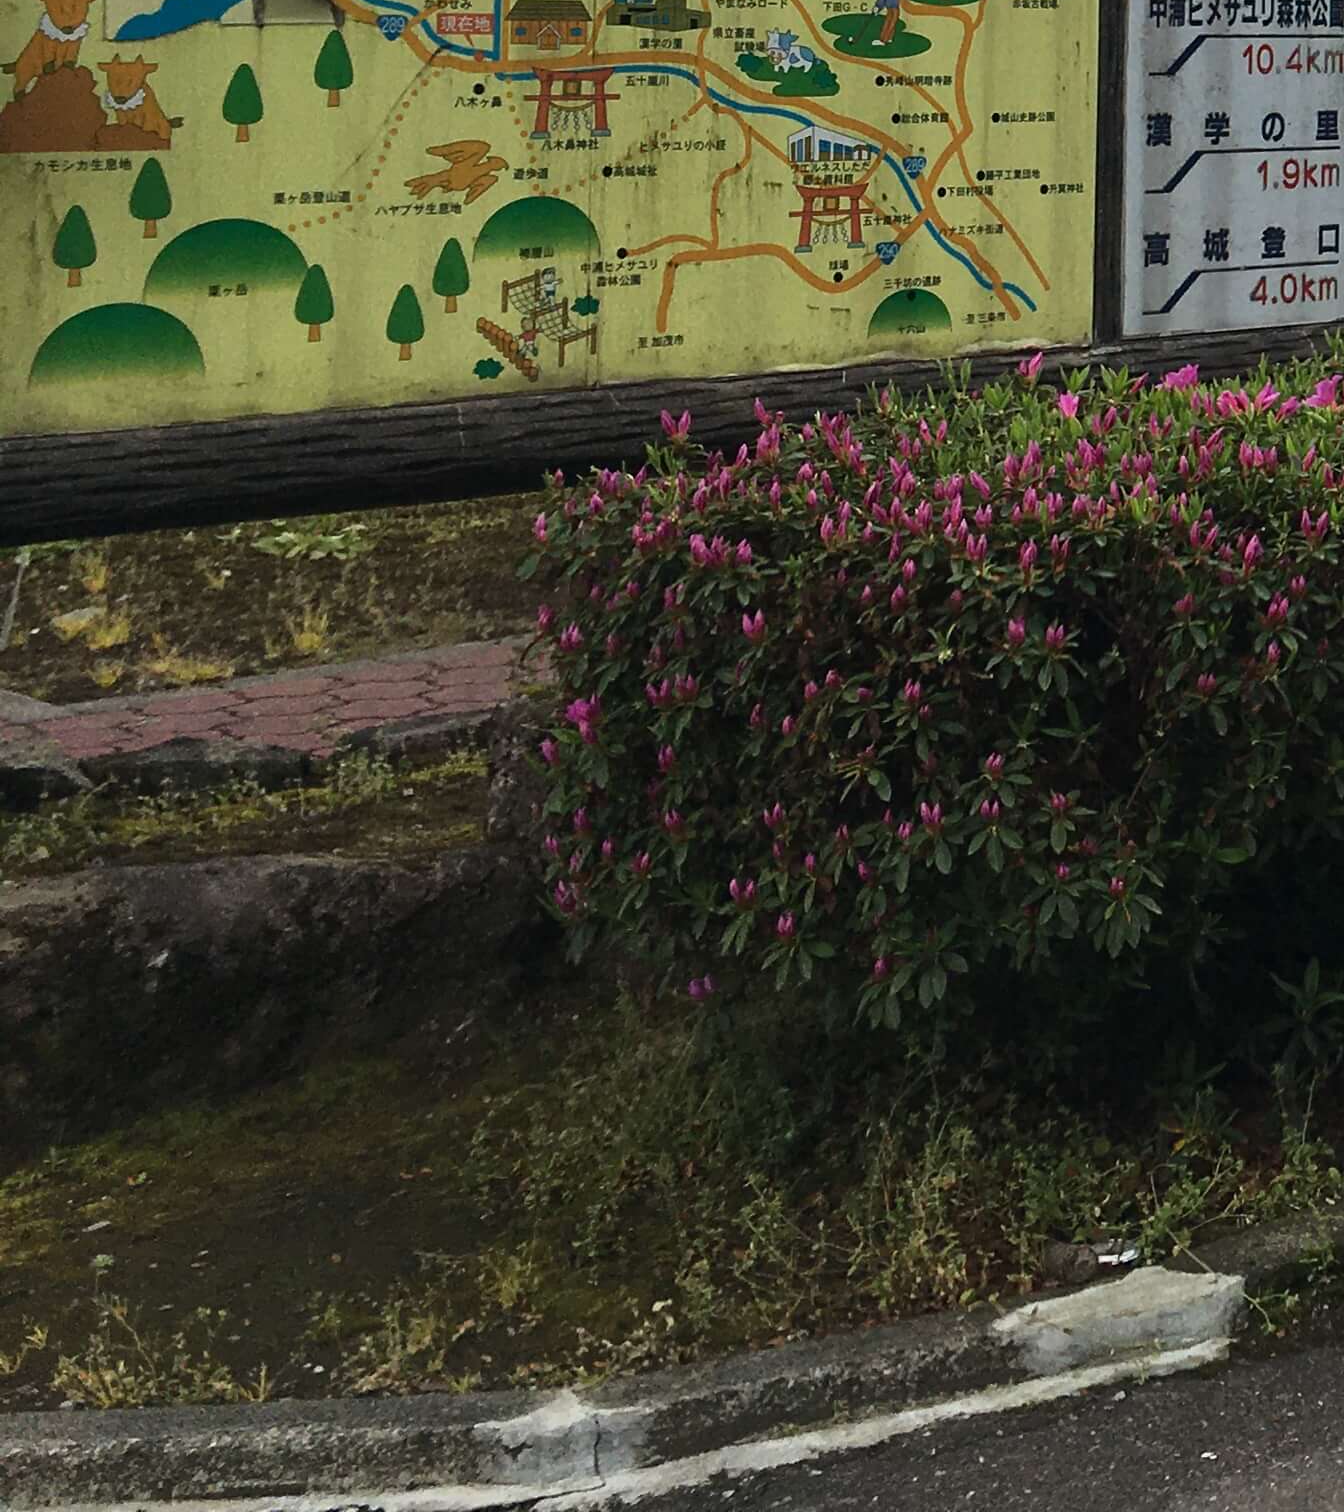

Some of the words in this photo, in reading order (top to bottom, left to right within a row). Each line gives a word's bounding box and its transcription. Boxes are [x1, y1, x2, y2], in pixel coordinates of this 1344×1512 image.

[380, 17, 406, 33] 289
[439, 16, 491, 33] 現在地
[1241, 43, 1344, 75] 10.4km
[1145, 109, 1340, 148] 漢学の里
[34, 158, 132, 173] カモシカ生息地
[513, 167, 549, 180] 遊歩道
[1256, 158, 1341, 191] 1.9km
[375, 202, 463, 216] ハヤブサ生息地
[1143, 224, 1340, 269] 高城登口
[1250, 273, 1339, 306] 4.0km
